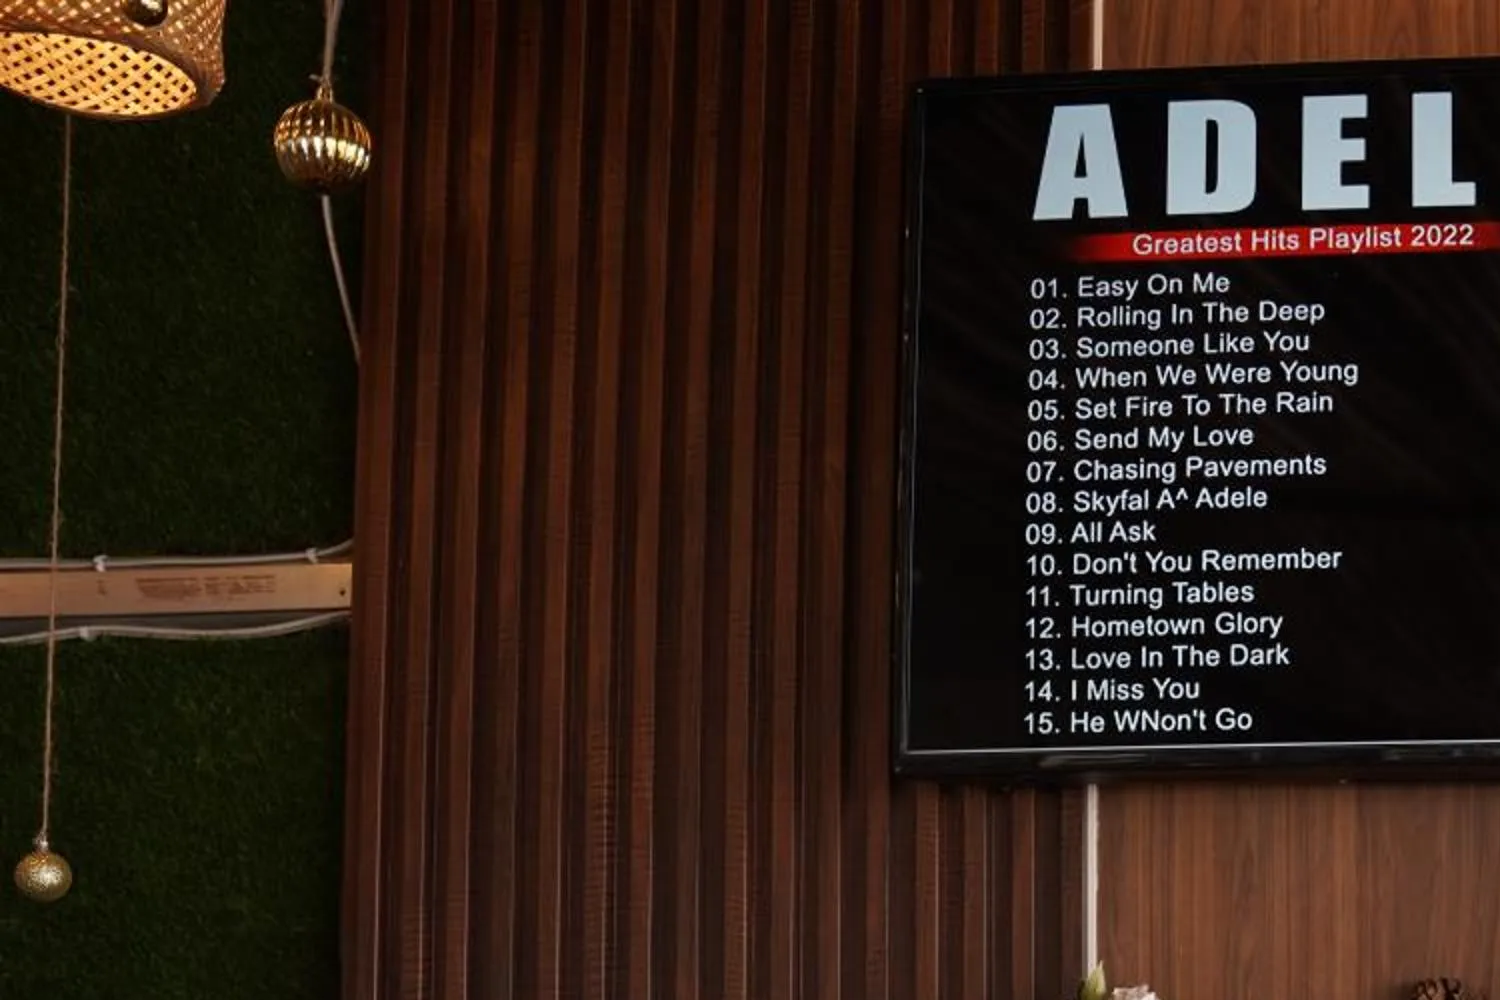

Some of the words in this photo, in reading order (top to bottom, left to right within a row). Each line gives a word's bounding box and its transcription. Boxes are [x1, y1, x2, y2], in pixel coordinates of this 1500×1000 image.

[1132, 231, 1243, 256] Greatest
[1250, 228, 1301, 252] Hits
[1309, 225, 1402, 253] Playlist
[1410, 223, 1475, 248] 2022
[1030, 278, 1067, 299] 01.
[1078, 276, 1139, 302] Easy
[1147, 273, 1183, 295] On
[1193, 271, 1231, 293] Me
[1029, 307, 1067, 330] 02.
[1077, 305, 1161, 331] Rolling
[1171, 303, 1193, 325] In
[1202, 301, 1249, 323] The
[1259, 300, 1325, 326] Deep
[1029, 338, 1067, 361] 03.
[1076, 336, 1195, 359] Someone
[1203, 332, 1255, 354] Like
[1263, 330, 1310, 353] You
[1028, 368, 1065, 391] 04.
[1075, 366, 1147, 389] When
[1155, 364, 1197, 386] We
[1205, 362, 1272, 385] Were
[1279, 360, 1359, 387] Young
[1027, 399, 1065, 422] 05.
[1075, 397, 1117, 420] Set
[1125, 395, 1173, 418] Fire
[1181, 394, 1211, 416] To
[1218, 393, 1267, 415] The
[1276, 391, 1333, 413] Rain
[1027, 429, 1065, 452] 06.
[1074, 427, 1139, 451] Send
[1148, 426, 1185, 453] My
[1193, 425, 1254, 447] Love
[1026, 460, 1064, 483] 07.
[1073, 457, 1176, 485] Chasing
[1185, 454, 1327, 478] Pavements
[1025, 491, 1064, 514] 08.
[1073, 488, 1150, 517] Skyfal
[1195, 485, 1268, 509] Adele
[1025, 522, 1063, 545] 09.
[1070, 521, 1103, 543] All
[1108, 519, 1157, 543] Ask
[1027, 554, 1063, 577] 10.
[1073, 551, 1137, 575] Don't
[1145, 550, 1192, 573] You
[1201, 547, 1343, 572] Remember
[1026, 585, 1060, 607] 11.
[1069, 583, 1163, 611] Turning
[1171, 580, 1255, 604] Tables
[1025, 616, 1061, 639] 12.
[1071, 615, 1205, 638] Hometown
[1214, 611, 1284, 639] Glory
[1025, 648, 1061, 671] 13.
[1071, 647, 1132, 670] Love
[1141, 645, 1163, 668] In
[1171, 644, 1221, 667] The
[1229, 642, 1290, 666] Dark
[1025, 679, 1060, 702] 14.
[1071, 679, 1077, 701] I
[1087, 678, 1145, 701] Miss
[1152, 677, 1200, 700] You
[1024, 711, 1060, 735] 15.
[1070, 711, 1105, 733] He
[1113, 708, 1207, 733] WNon't
[1215, 707, 1253, 731] Go
